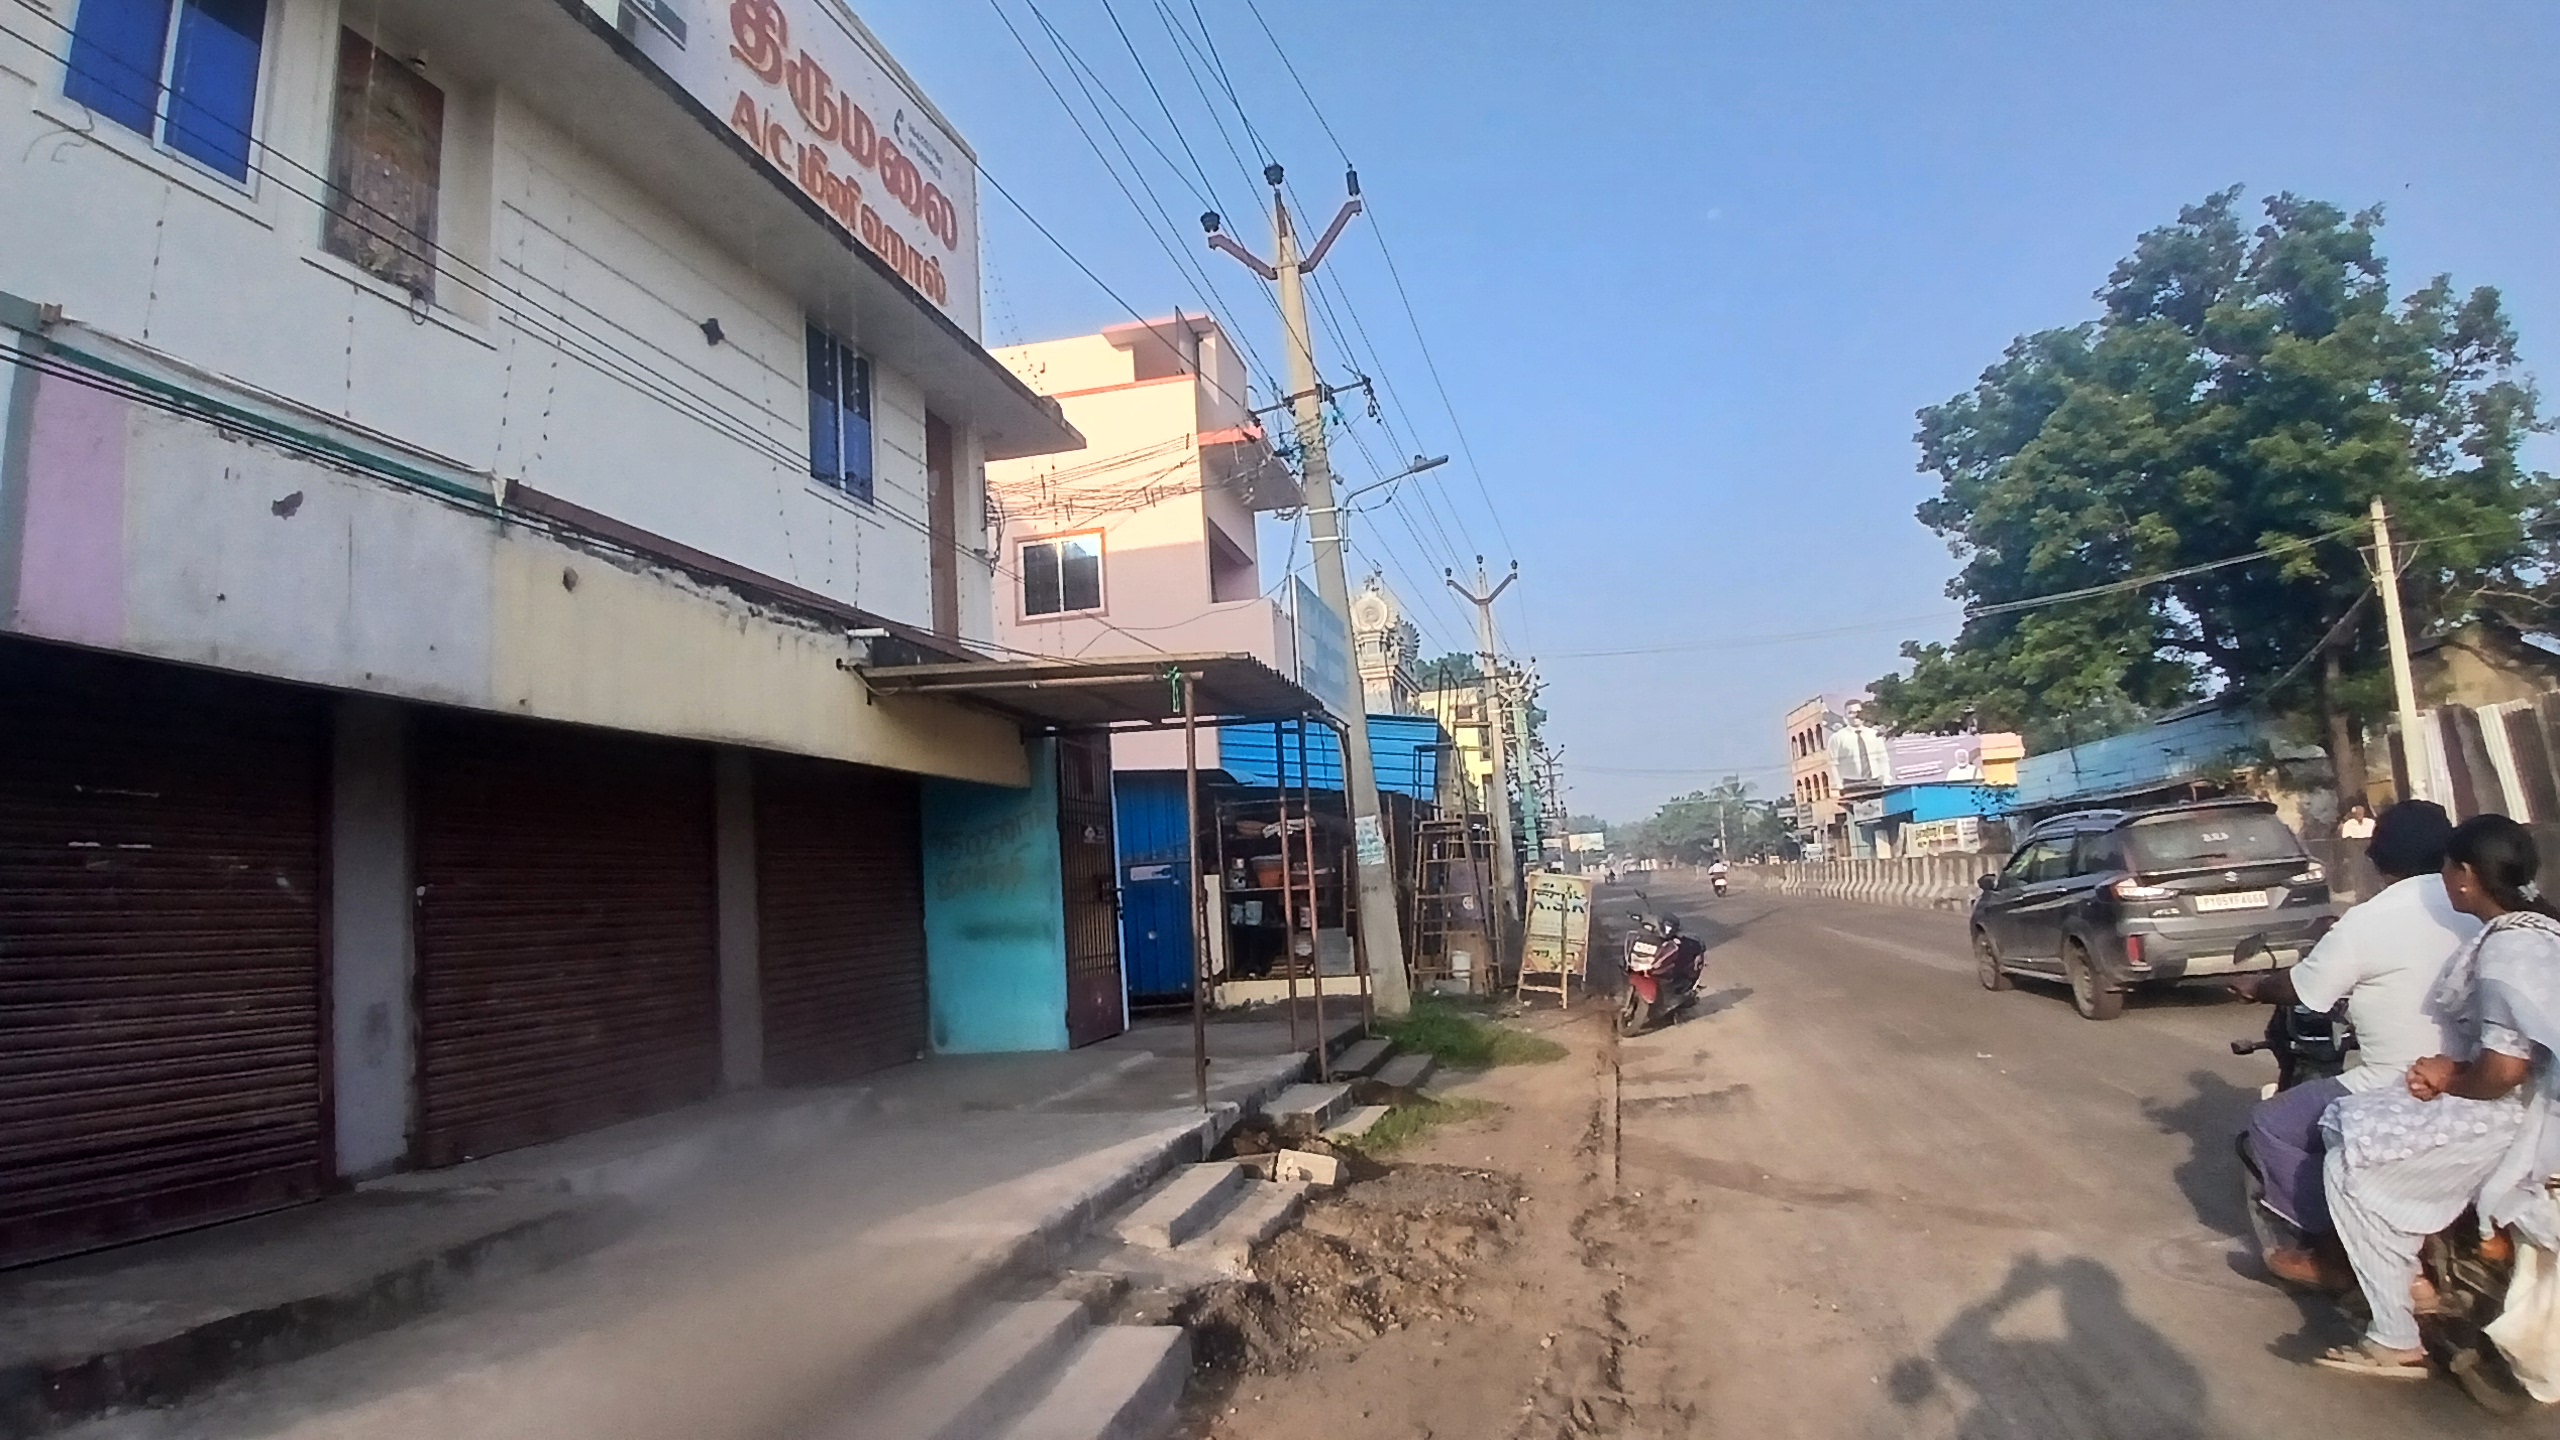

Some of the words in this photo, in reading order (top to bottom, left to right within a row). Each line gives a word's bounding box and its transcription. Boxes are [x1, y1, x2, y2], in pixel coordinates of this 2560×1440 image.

[730, 0, 957, 251] திருமலை
[730, 90, 792, 171] A/C
[860, 203, 947, 306] ஹால்
